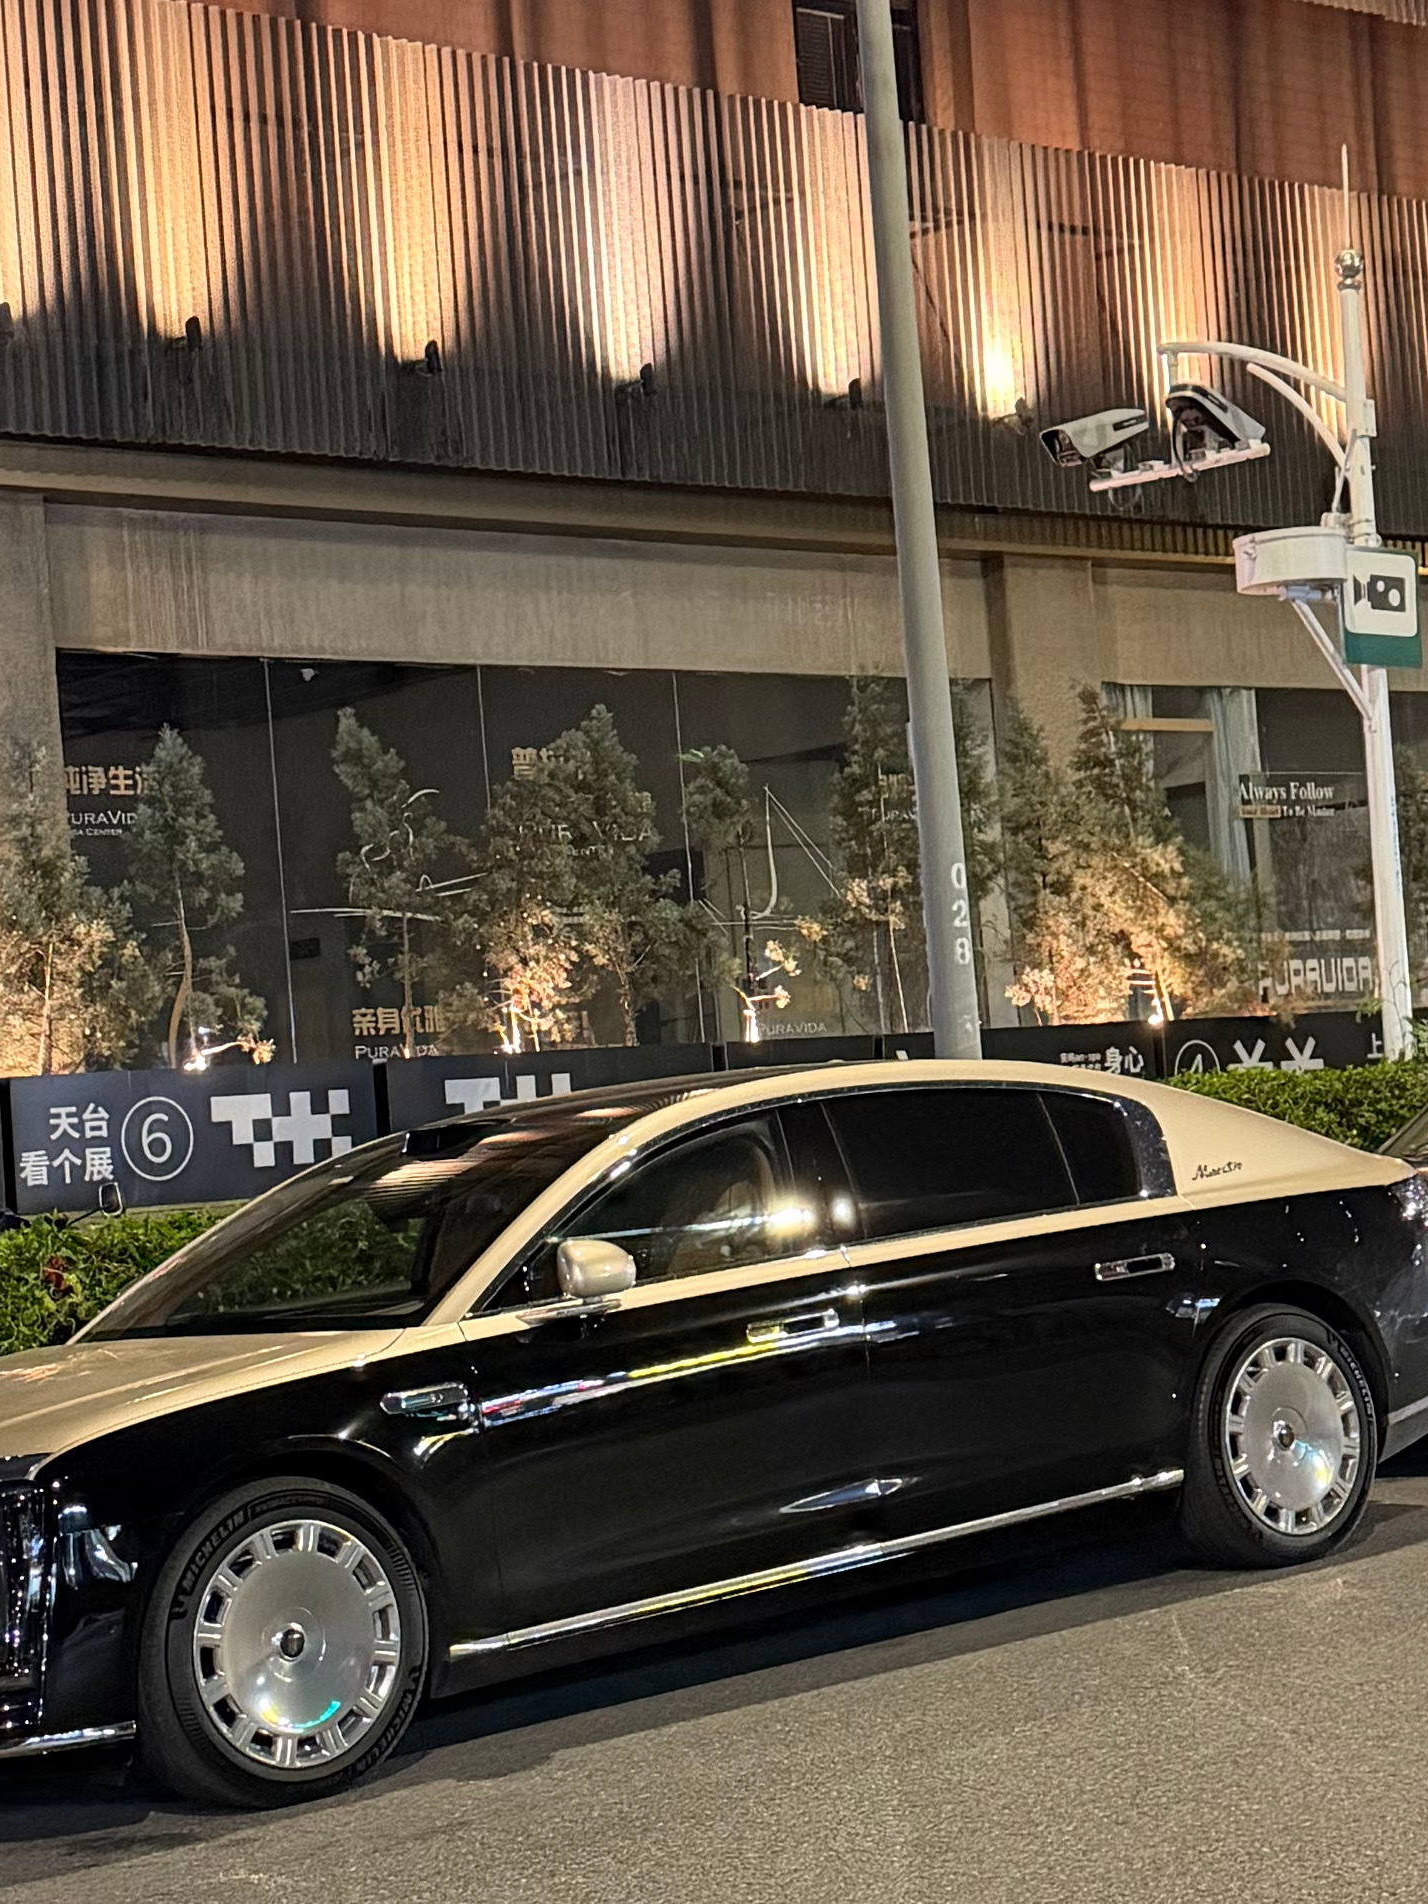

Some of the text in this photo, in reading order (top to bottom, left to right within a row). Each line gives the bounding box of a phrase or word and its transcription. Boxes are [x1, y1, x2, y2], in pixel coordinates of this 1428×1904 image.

[1240, 781, 1335, 803] Always Follow
[950, 862, 971, 966] 028
[48, 1103, 109, 1142] 天台
[19, 1146, 116, 1187] 看个展
[181, 1508, 246, 1592] MICHELIN
